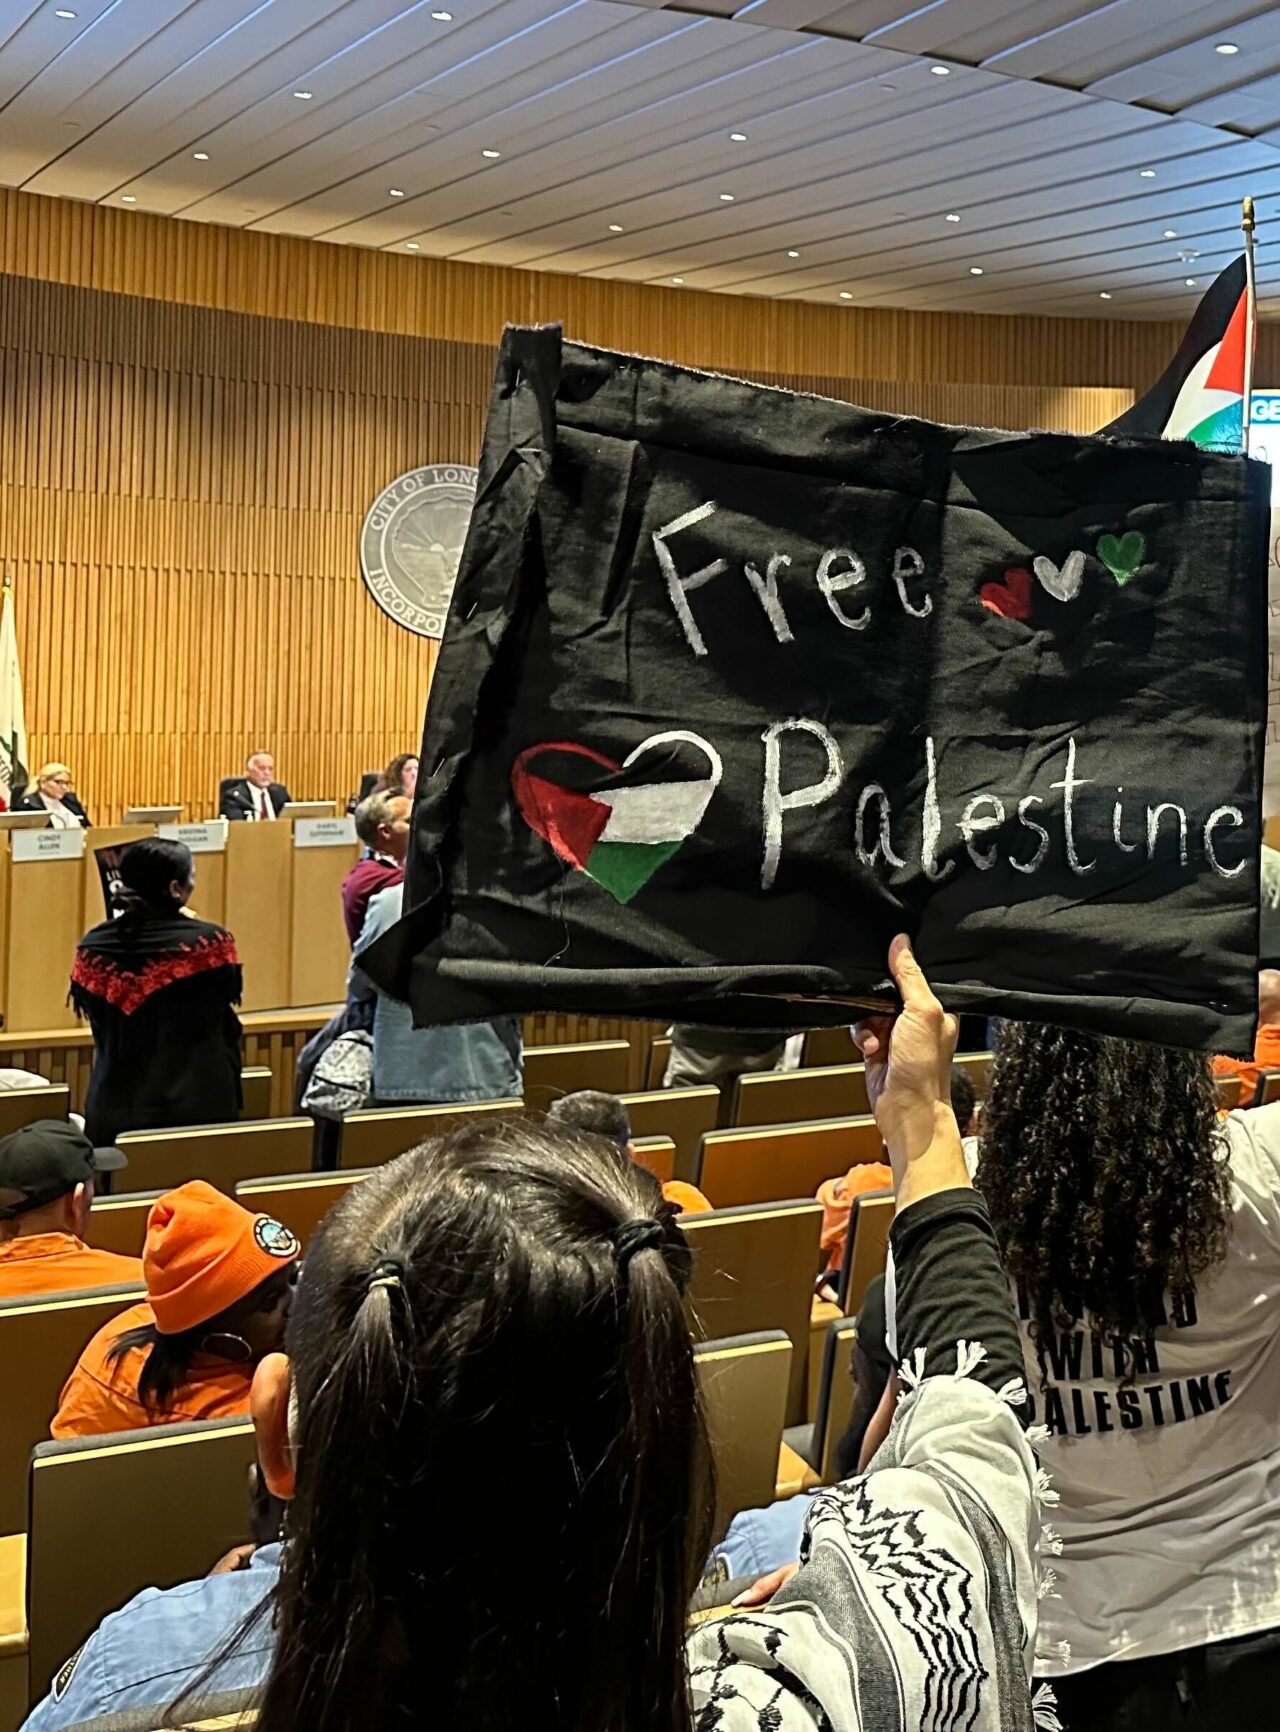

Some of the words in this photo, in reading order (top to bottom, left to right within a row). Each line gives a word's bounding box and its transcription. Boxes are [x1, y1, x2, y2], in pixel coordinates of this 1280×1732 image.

[370, 487, 402, 531] CITY
[402, 473, 425, 492] OF
[370, 569, 440, 632] INCORPO
[652, 500, 934, 657] Free
[761, 718, 1249, 890] Palestine
[1050, 1331, 1161, 1381] WITH
